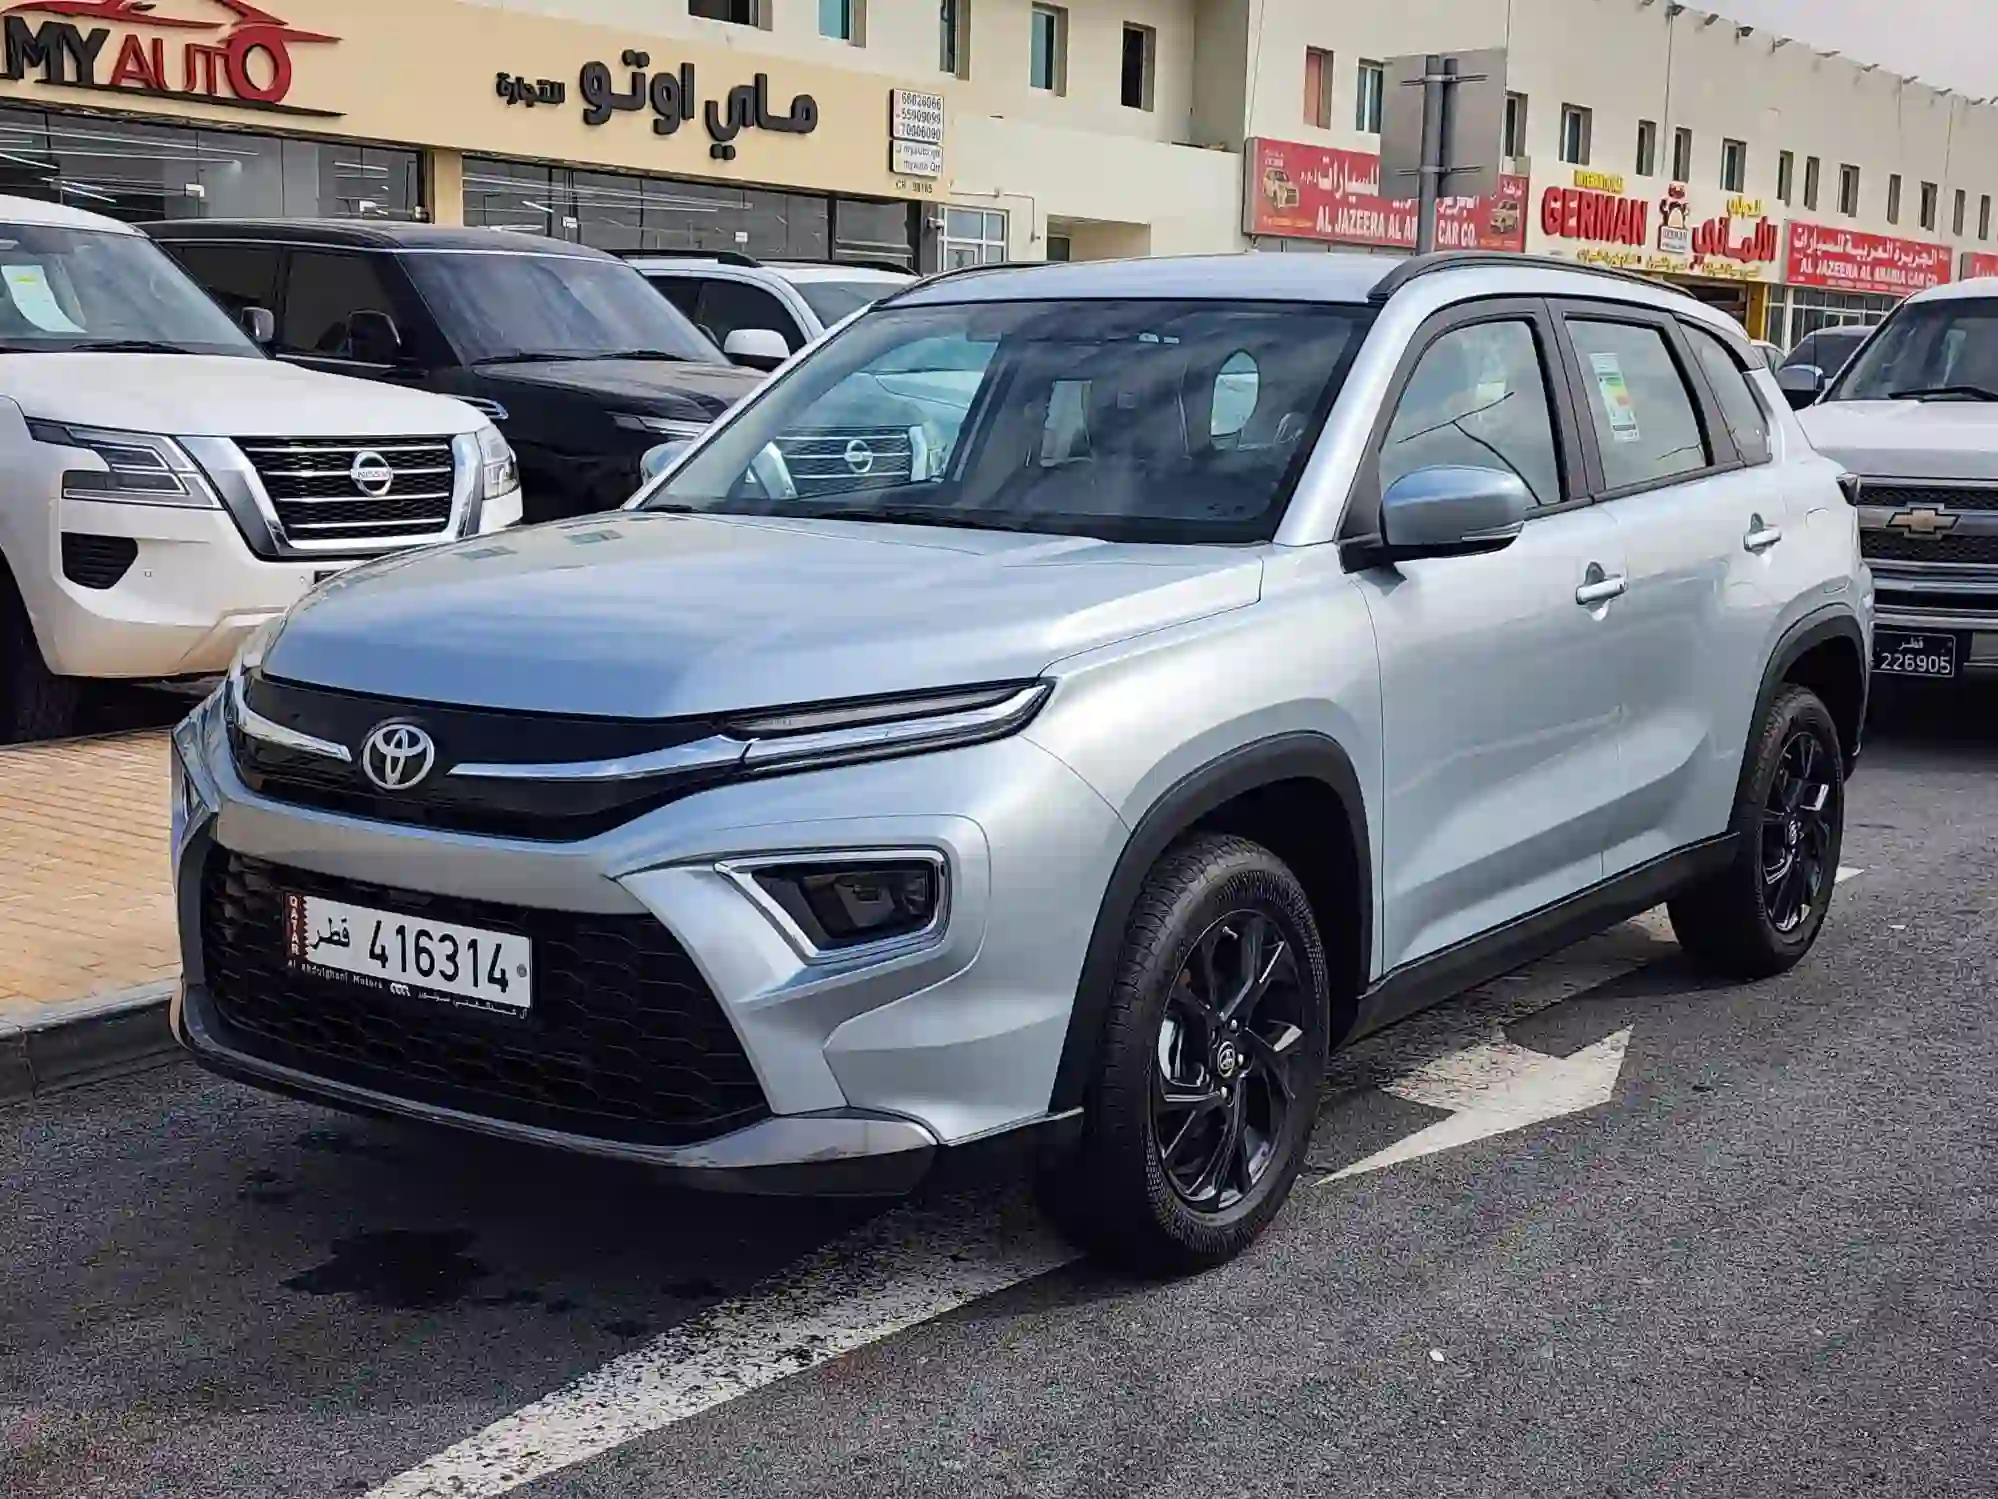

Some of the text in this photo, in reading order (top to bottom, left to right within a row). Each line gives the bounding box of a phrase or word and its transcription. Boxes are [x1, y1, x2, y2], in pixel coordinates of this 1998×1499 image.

[579, 48, 695, 137] اوتو
[705, 73, 819, 161] ماي
[1316, 205, 1332, 233] AL
[1334, 207, 1385, 237] JAZEERA
[1387, 214, 1401, 240] AL
[1438, 219, 1459, 245] CAR
[1541, 186, 1648, 247] GERMAN
[1880, 652, 1951, 674] 226905
[1897, 636, 1924, 650] قطر
[289, 895, 300, 956] QATAR
[310, 917, 350, 950] قطر
[368, 919, 509, 994] 416314
